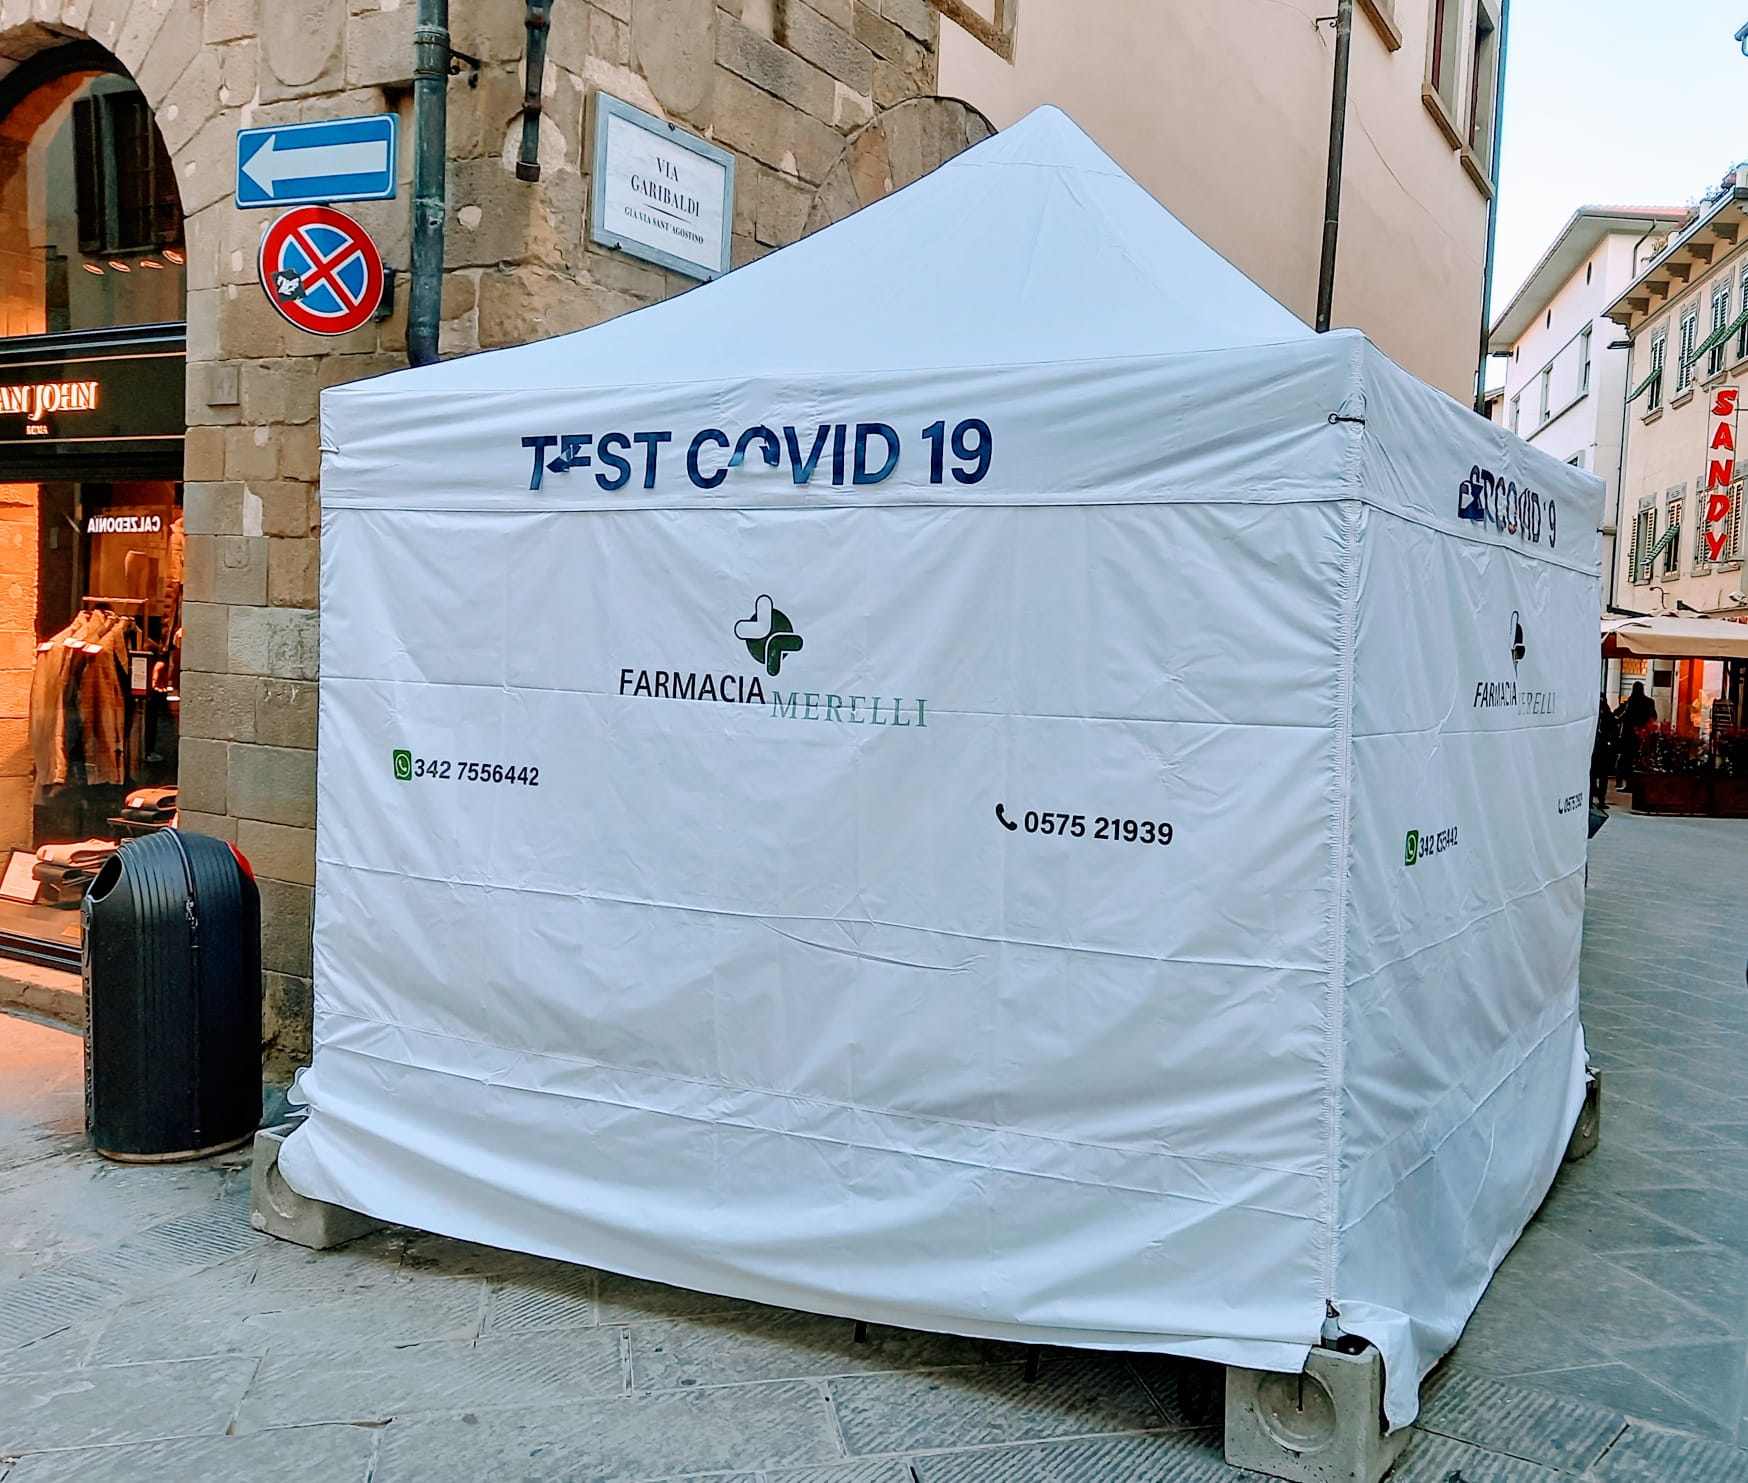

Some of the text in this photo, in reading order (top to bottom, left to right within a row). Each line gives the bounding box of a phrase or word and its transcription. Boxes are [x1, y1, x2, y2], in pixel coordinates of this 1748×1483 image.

[656, 157, 680, 182] VIA
[630, 174, 701, 217] GARIBALDI
[638, 211, 652, 225] VIA
[28, 382, 99, 421] JOHN
[686, 423, 901, 489] COVID
[921, 418, 993, 484] 19
[1704, 389, 1738, 561] SANDY
[619, 668, 767, 705] FARMACIA
[770, 690, 928, 727] MERELLI
[414, 758, 540, 786] 342 7556442
[1024, 810, 1173, 846] 0575 21939
